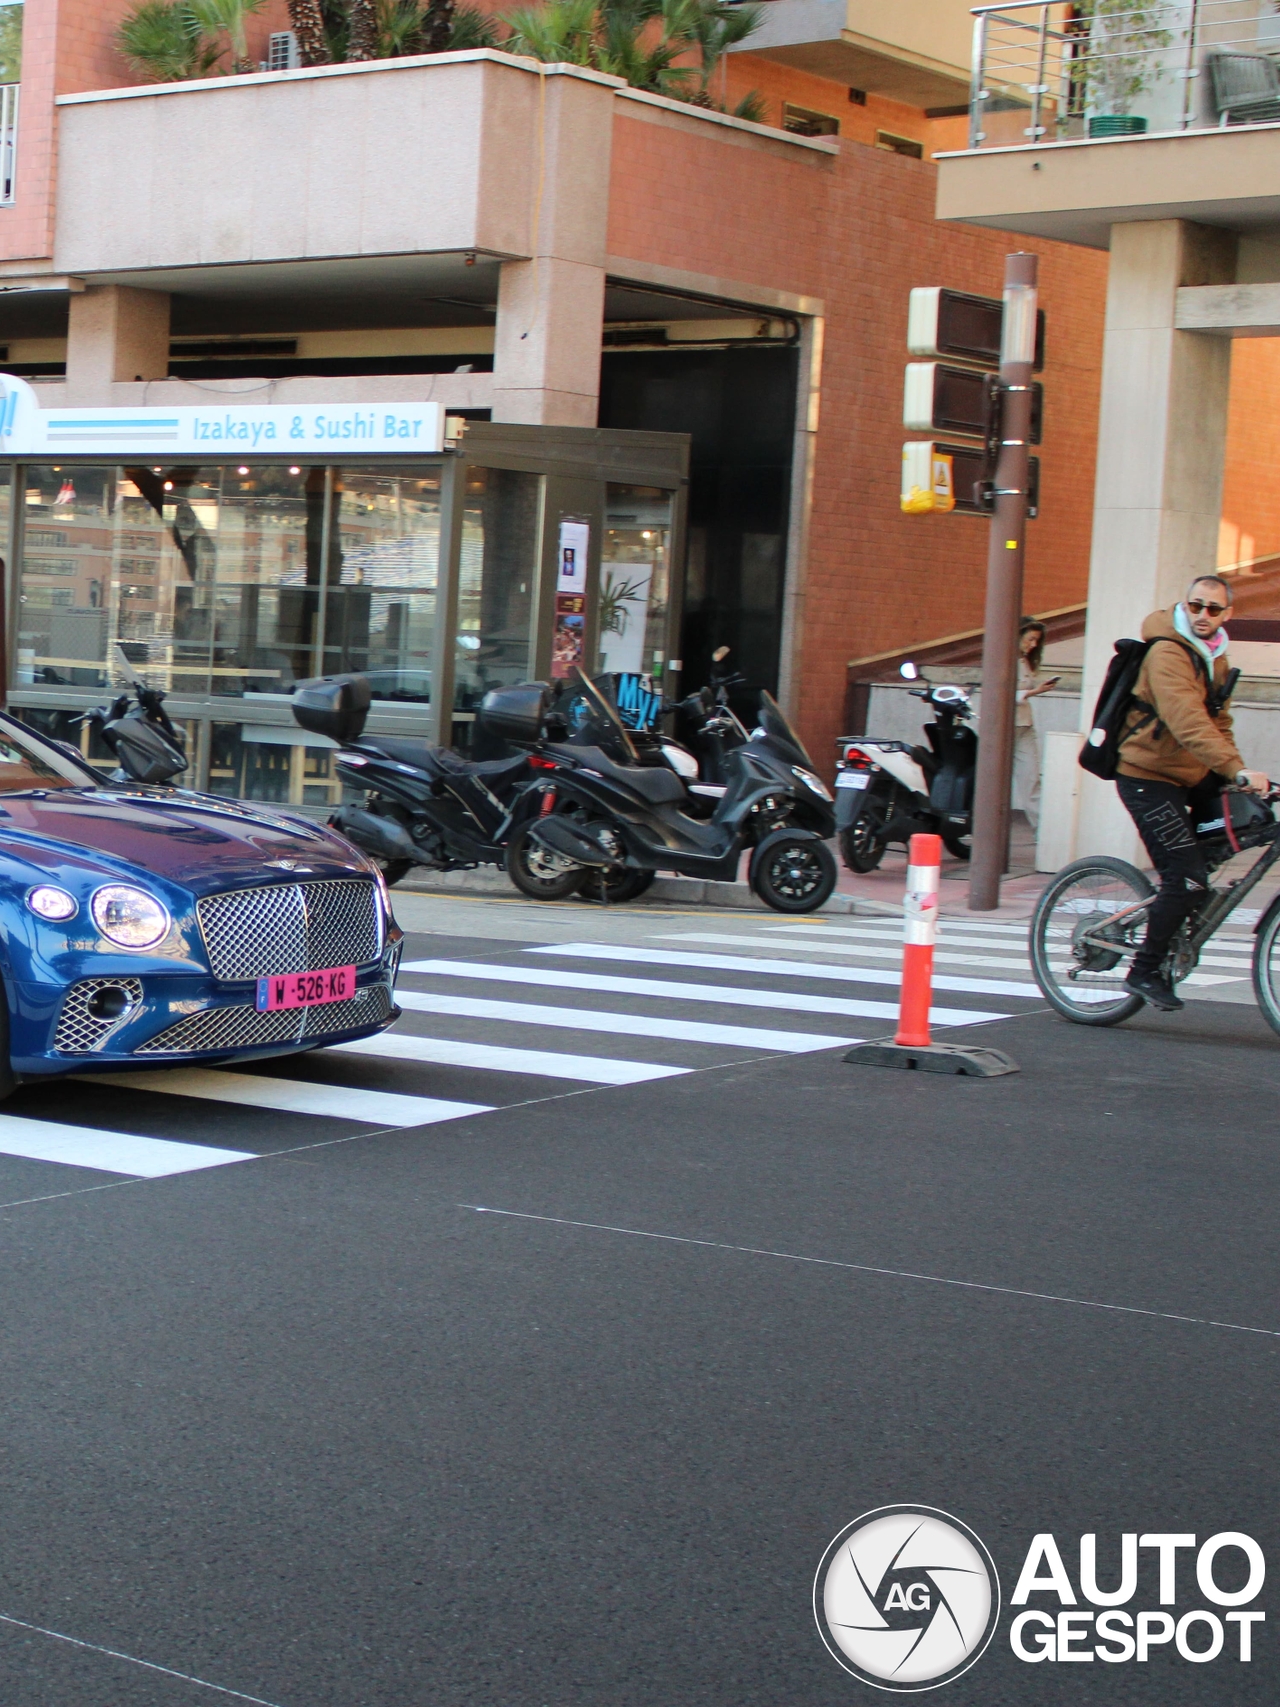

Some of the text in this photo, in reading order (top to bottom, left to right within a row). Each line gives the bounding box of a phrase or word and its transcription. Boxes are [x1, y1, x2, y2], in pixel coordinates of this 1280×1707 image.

[193, 411, 423, 447] Izakaya & Sushi Bar
[1143, 801, 1197, 851] FLY
